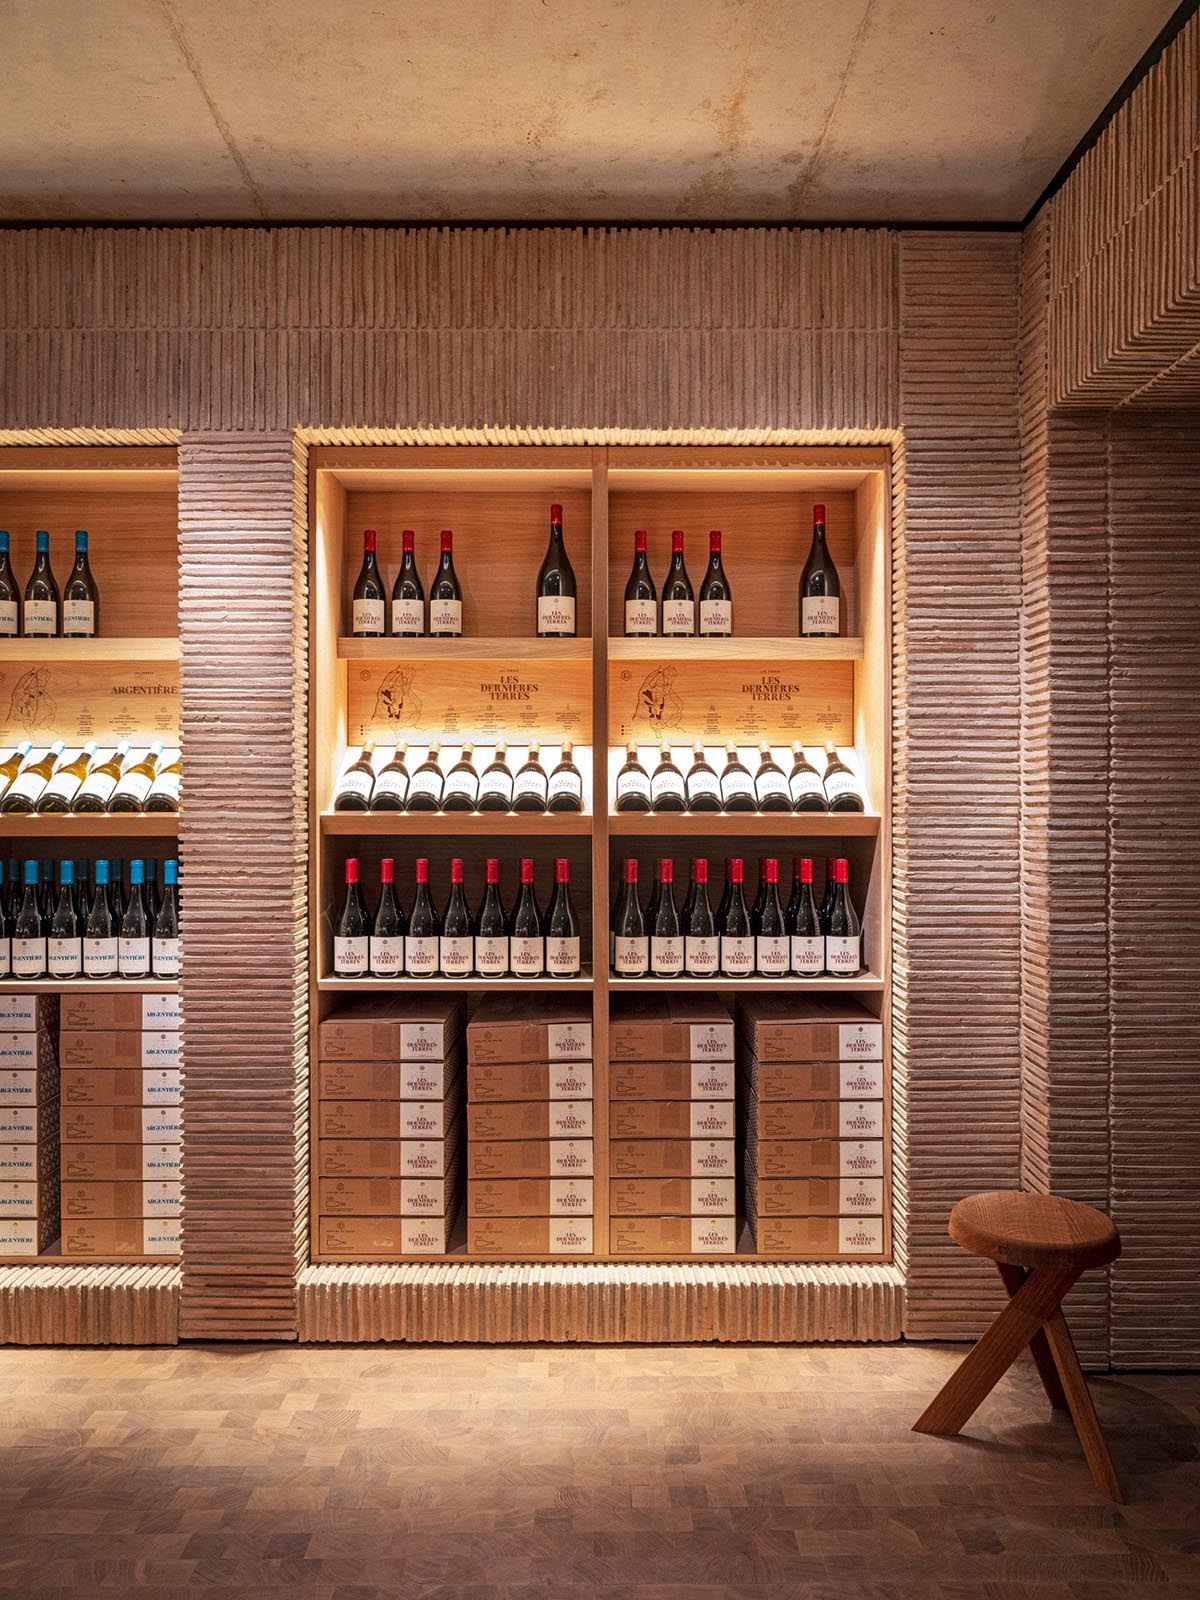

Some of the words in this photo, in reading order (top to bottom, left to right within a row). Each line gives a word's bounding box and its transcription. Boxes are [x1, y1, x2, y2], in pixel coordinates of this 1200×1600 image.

[500, 675, 519, 684] LES
[761, 676, 781, 685] LES
[111, 683, 178, 695] ARGENTIÈRE
[488, 691, 530, 701] TERRES
[751, 692, 792, 701] TERRES
